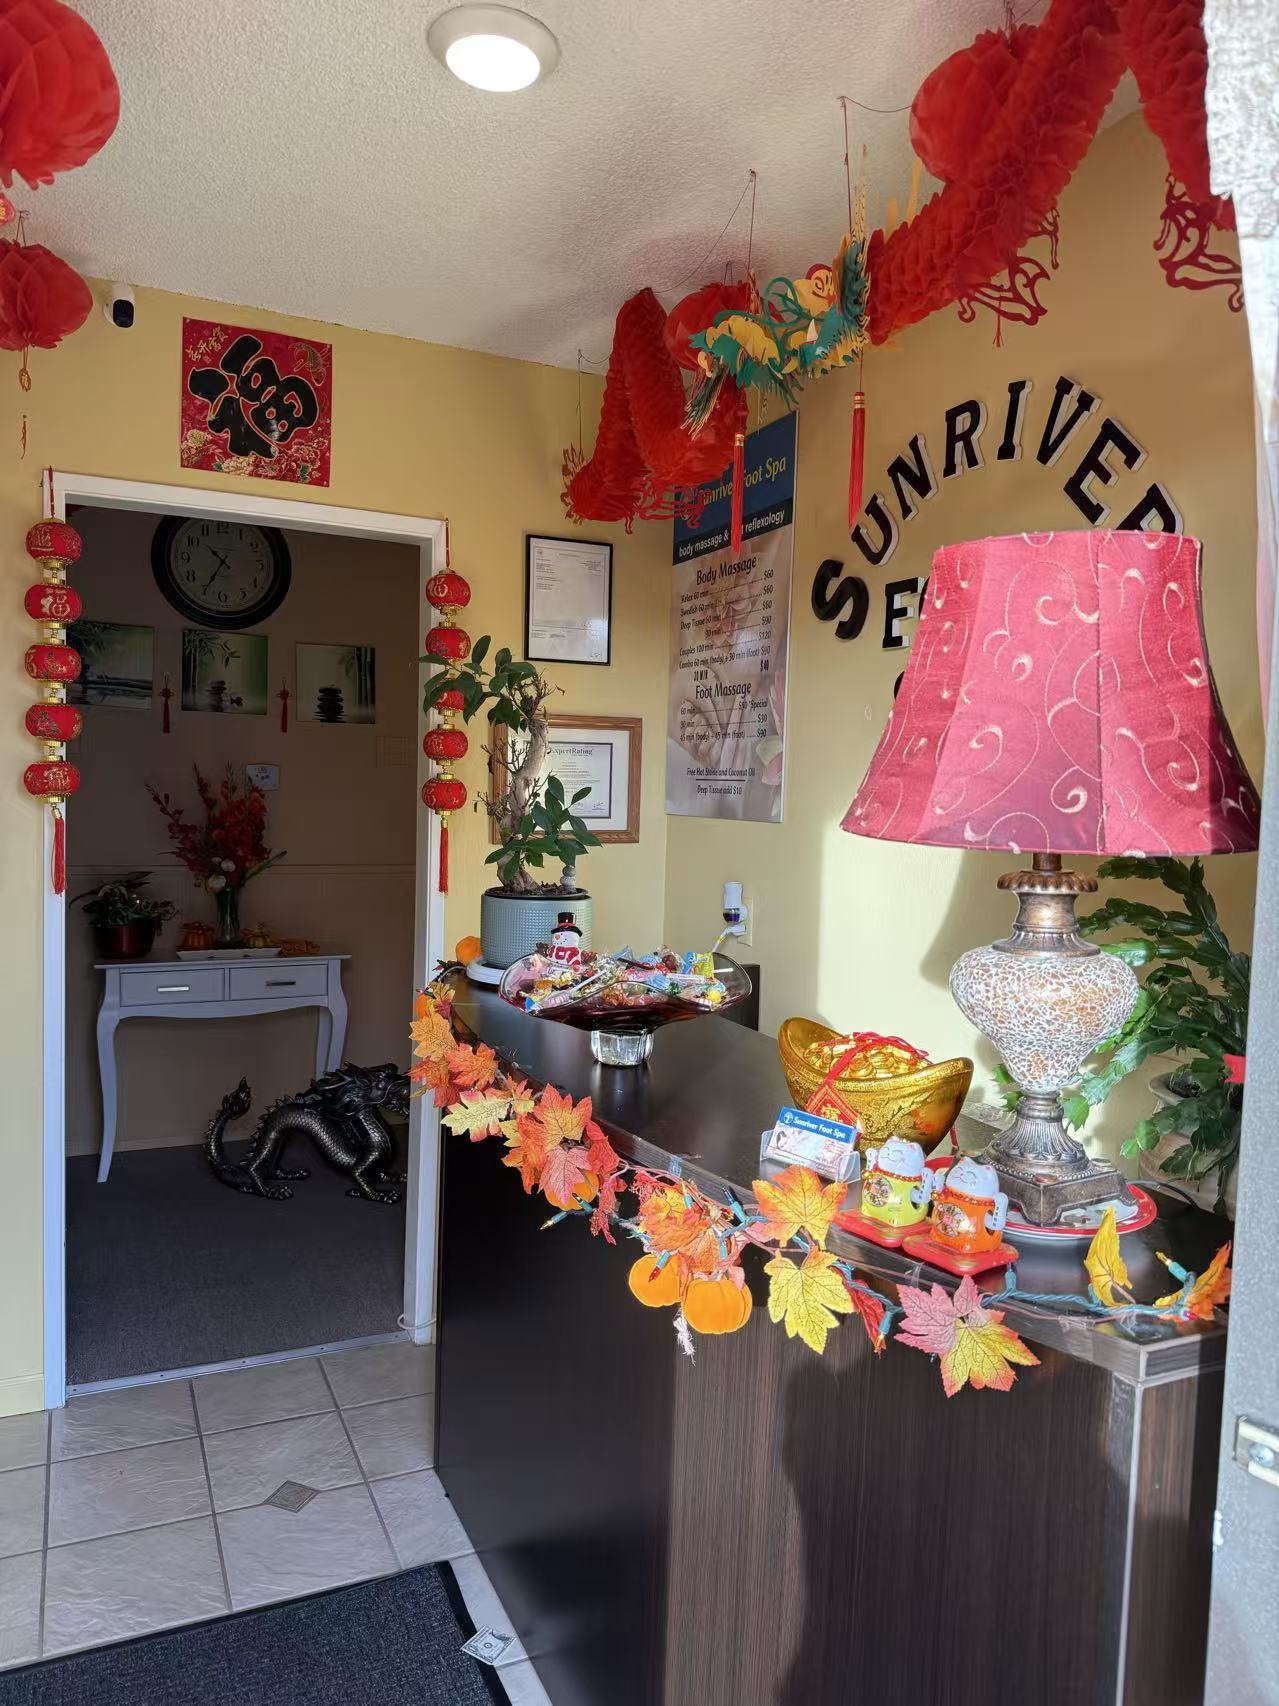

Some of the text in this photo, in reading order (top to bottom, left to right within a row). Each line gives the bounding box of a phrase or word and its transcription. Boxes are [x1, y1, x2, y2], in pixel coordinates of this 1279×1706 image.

[188, 334, 320, 460] 福
[743, 465, 763, 487] oot
[766, 457, 786, 481] Spa
[745, 510, 785, 532] reflexology
[187, 535, 200, 547] 10
[679, 543, 694, 557] body
[695, 533, 723, 552] massage
[724, 529, 729, 541] &
[181, 551, 191, 563] 9
[186, 569, 196, 583] 8
[696, 556, 757, 585] Body Massage
[217, 591, 228, 603] 6
[763, 584, 774, 596] $60
[696, 644, 704, 653] 120
[759, 630, 771, 641] $120
[695, 682, 752, 699] Foot Massage
[687, 767, 695, 776] Free
[696, 767, 705, 776] Hot
[718, 767, 728, 776] and
[733, 786, 742, 795] $10
[793, 1116, 846, 1138] Sunriver Foot Spa
